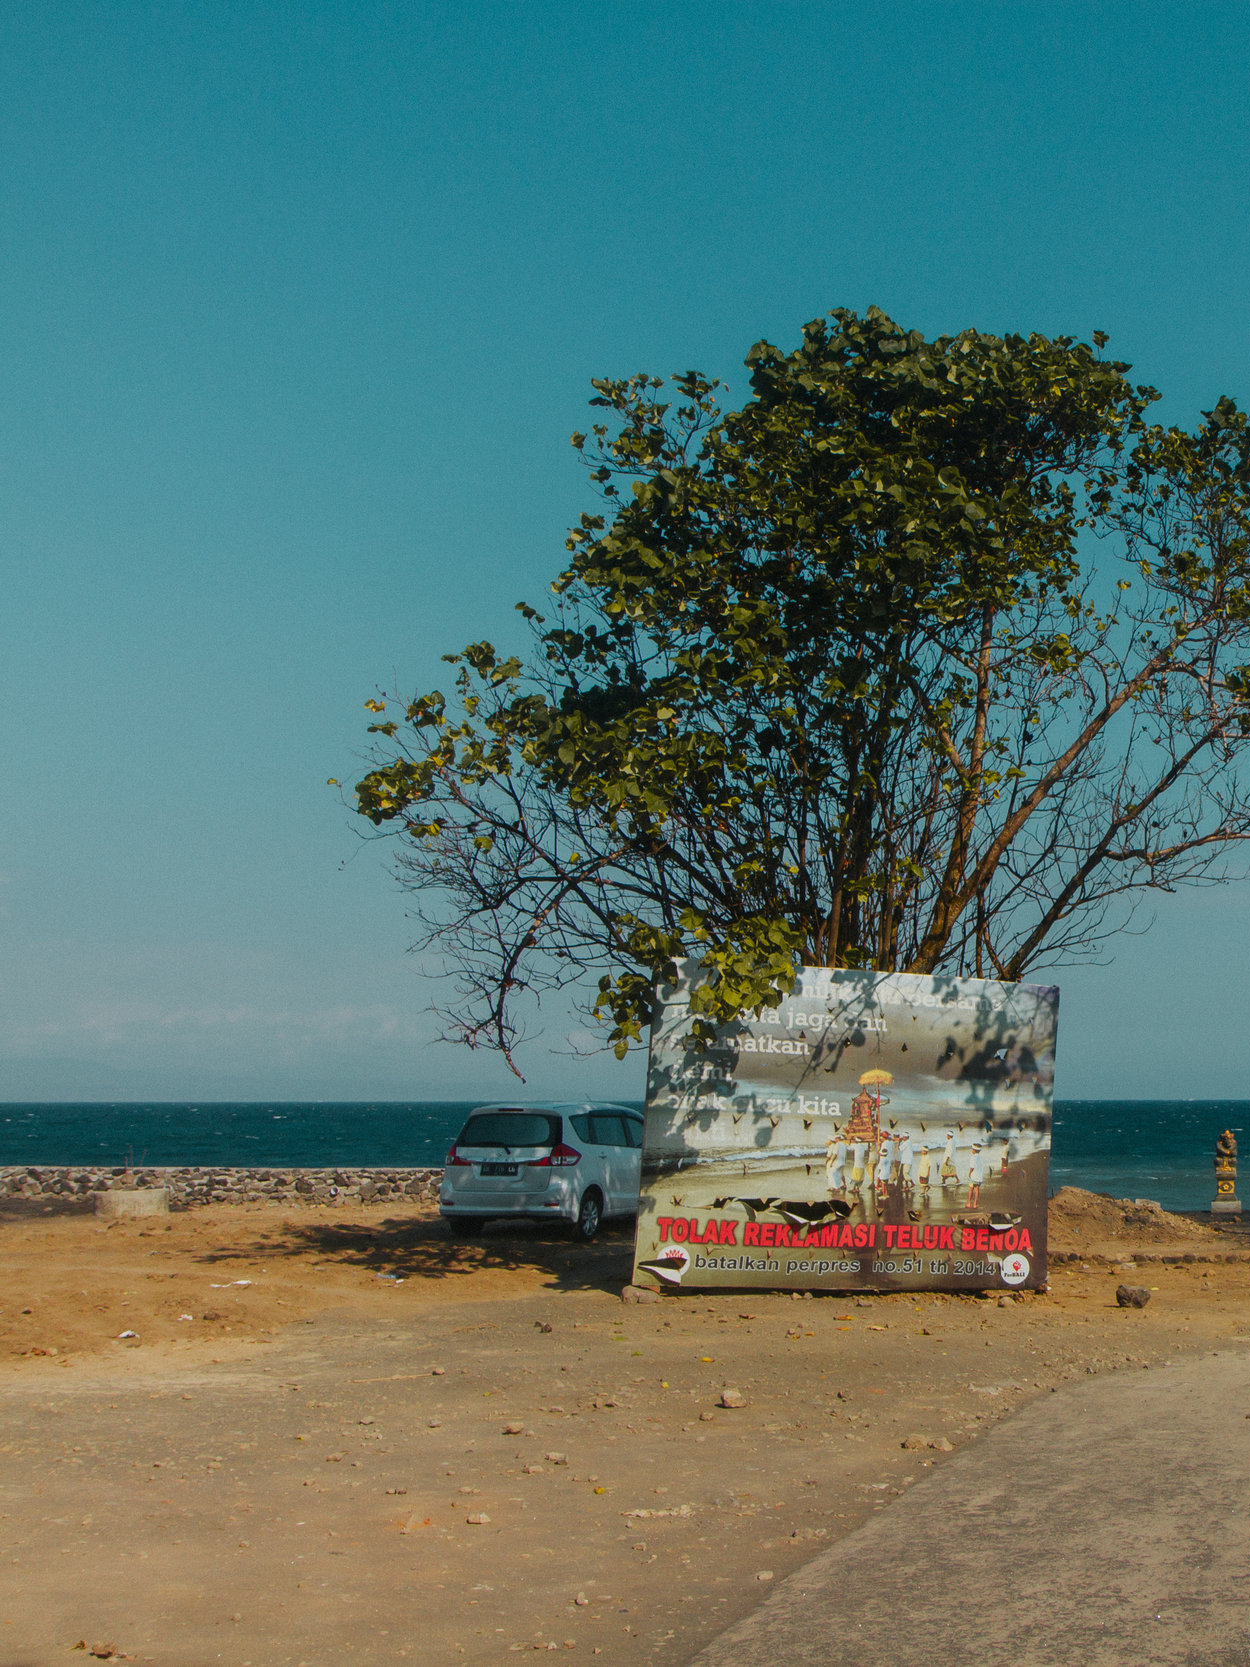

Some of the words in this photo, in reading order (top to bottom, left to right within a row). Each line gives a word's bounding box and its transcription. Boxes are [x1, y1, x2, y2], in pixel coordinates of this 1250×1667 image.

[786, 1007, 838, 1032] jaga
[797, 1094, 842, 1118] kita
[657, 1217, 738, 1245] TOLAK
[744, 1222, 876, 1248] REKLAMASI
[884, 1224, 955, 1249] TELUK
[961, 1227, 1032, 1251] BENOA
[694, 1254, 780, 1272] batalkan
[785, 1259, 861, 1276] perpres
[873, 1259, 923, 1273] no.51
[930, 1259, 949, 1275] th
[953, 1260, 997, 1276] 2014
